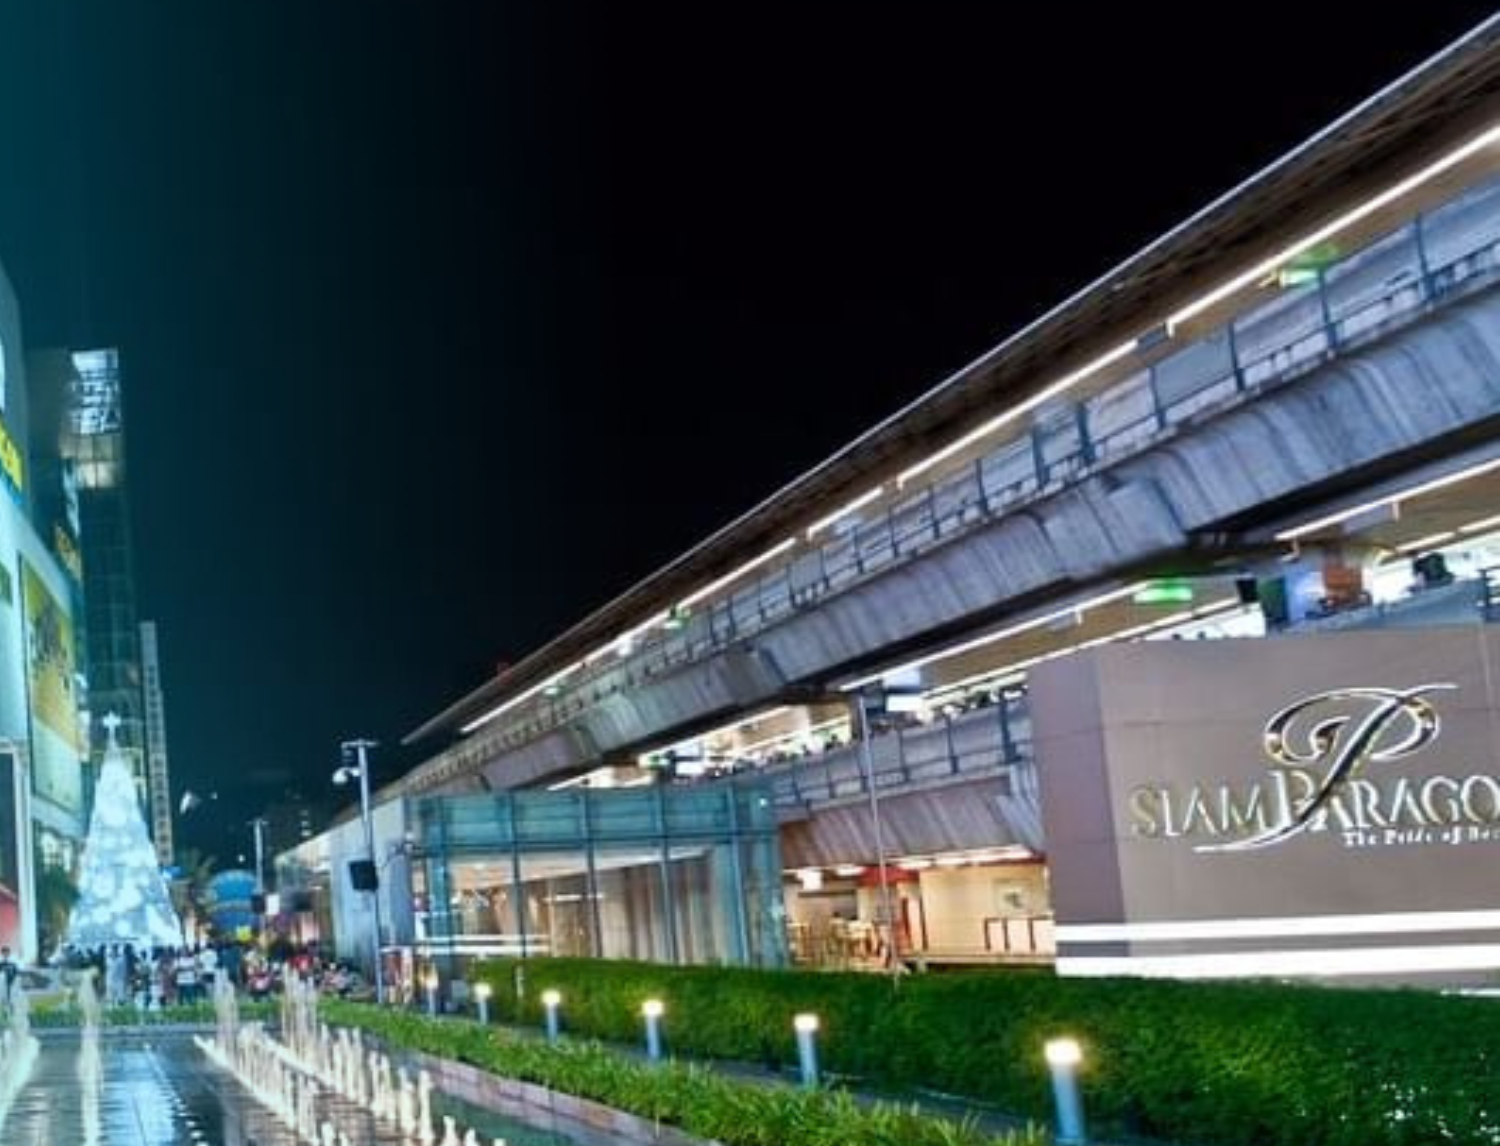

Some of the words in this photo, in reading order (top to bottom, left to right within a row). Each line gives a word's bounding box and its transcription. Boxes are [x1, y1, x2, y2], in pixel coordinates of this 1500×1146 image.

[1130, 782, 1268, 838] SIAM
[1267, 769, 1500, 834] PARAGO
[1342, 831, 1376, 847] The
[1442, 826, 1462, 845] of
